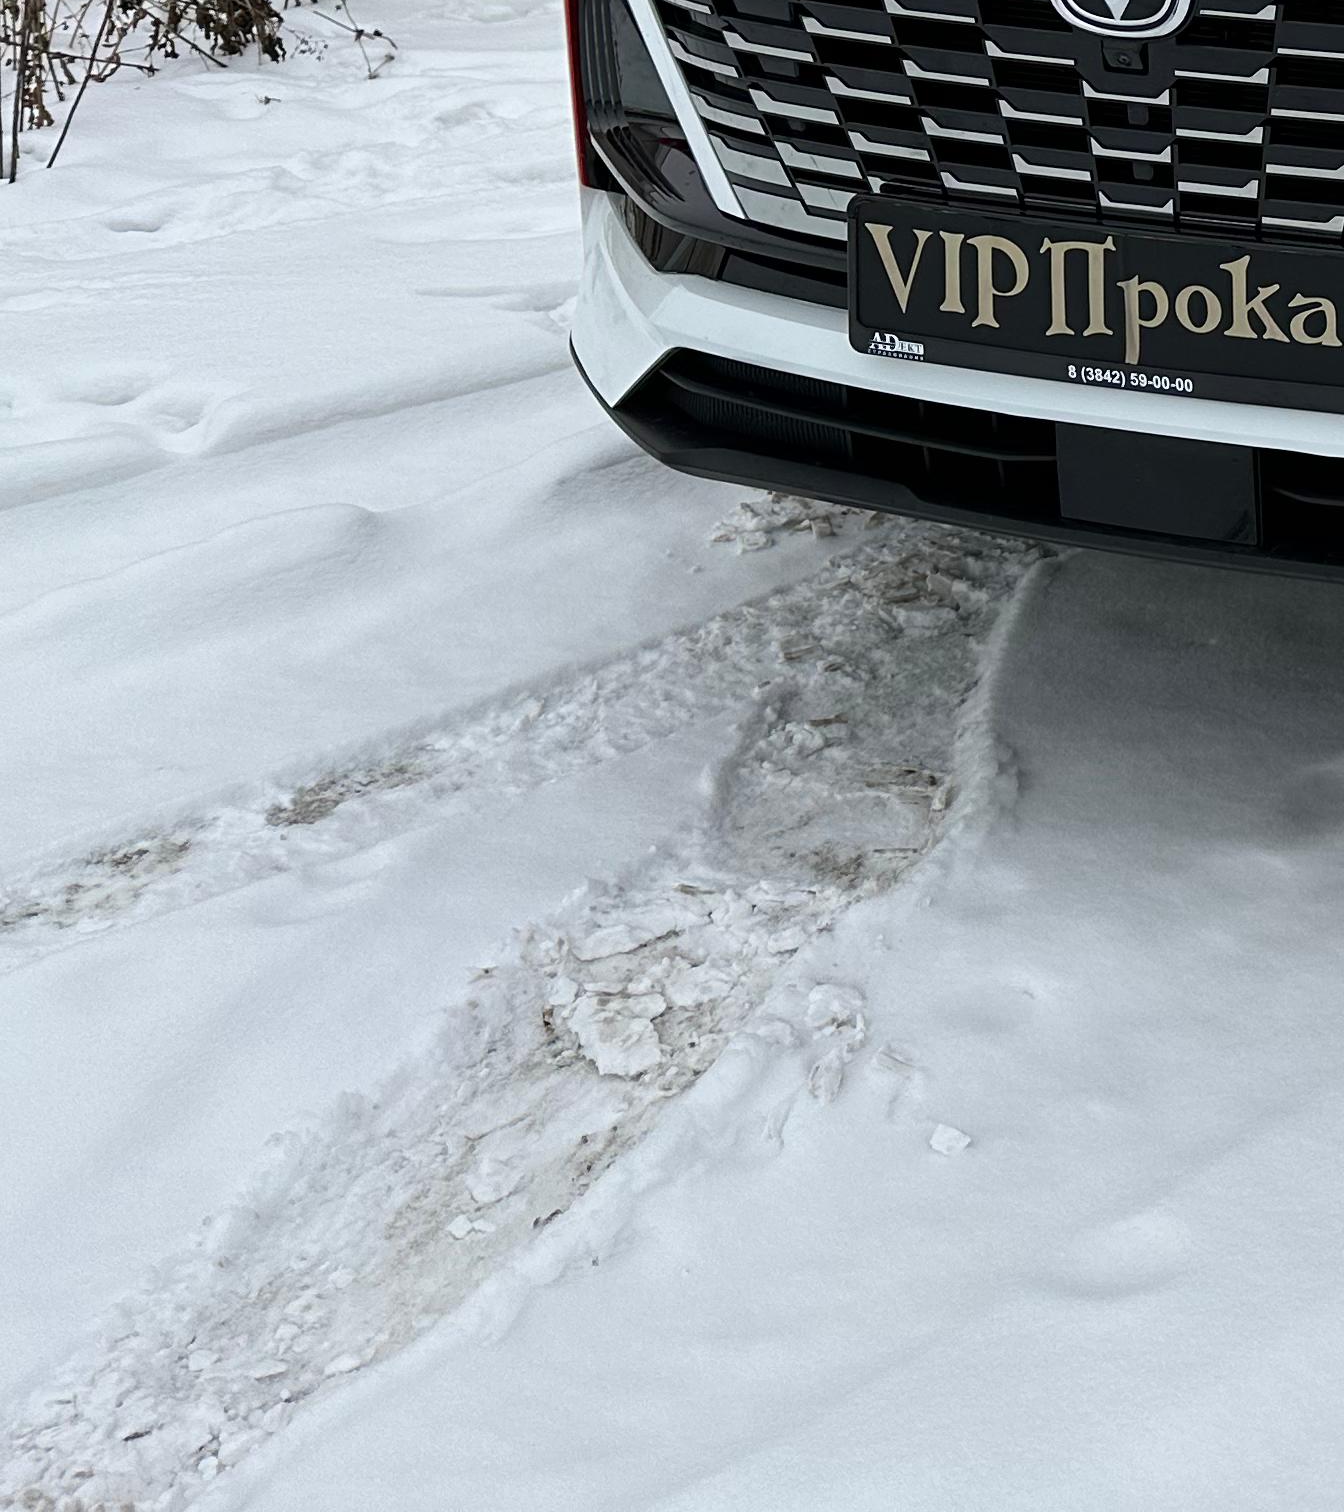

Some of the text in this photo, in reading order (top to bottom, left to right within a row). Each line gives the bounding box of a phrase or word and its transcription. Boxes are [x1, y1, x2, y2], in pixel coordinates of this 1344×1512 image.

[864, 221, 1030, 328] VIP
[1067, 364, 1193, 393] 8 (3842) 59-00-00
